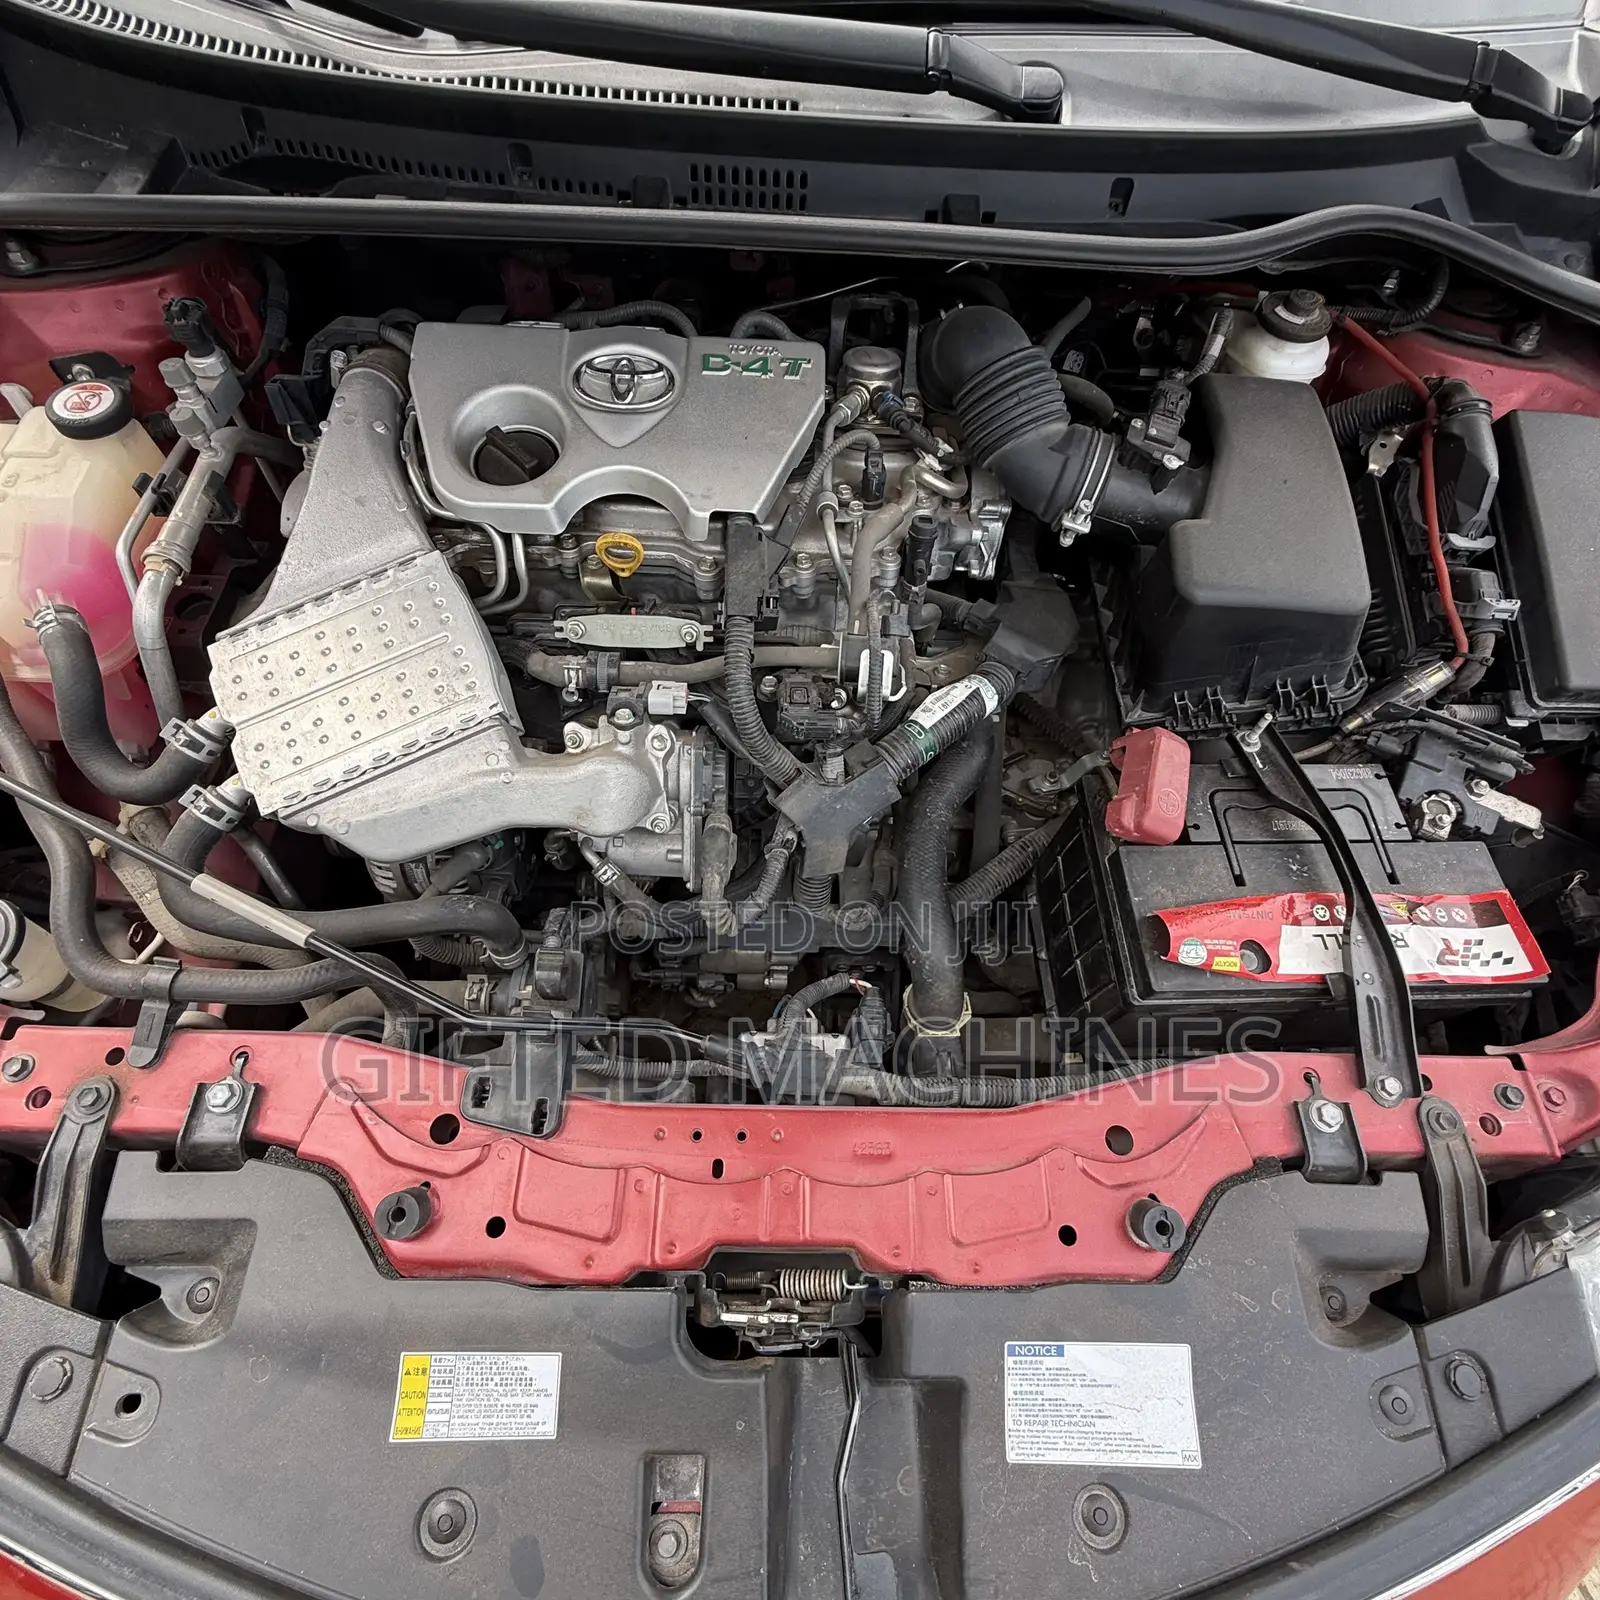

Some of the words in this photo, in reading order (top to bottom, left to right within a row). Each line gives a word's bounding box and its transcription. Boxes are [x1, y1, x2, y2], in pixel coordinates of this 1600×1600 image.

[728, 343, 782, 357] TOYOTA
[1015, 1345, 1058, 1356] NOTICE
[400, 1391, 426, 1400] CAUTION
[397, 1408, 424, 1417] ATTENTION
[1012, 1419, 1022, 1427] TO
[1024, 1419, 1049, 1428] REPAIR
[1051, 1420, 1096, 1428] TECHNICIAN
[1183, 1454, 1198, 1463] MX
